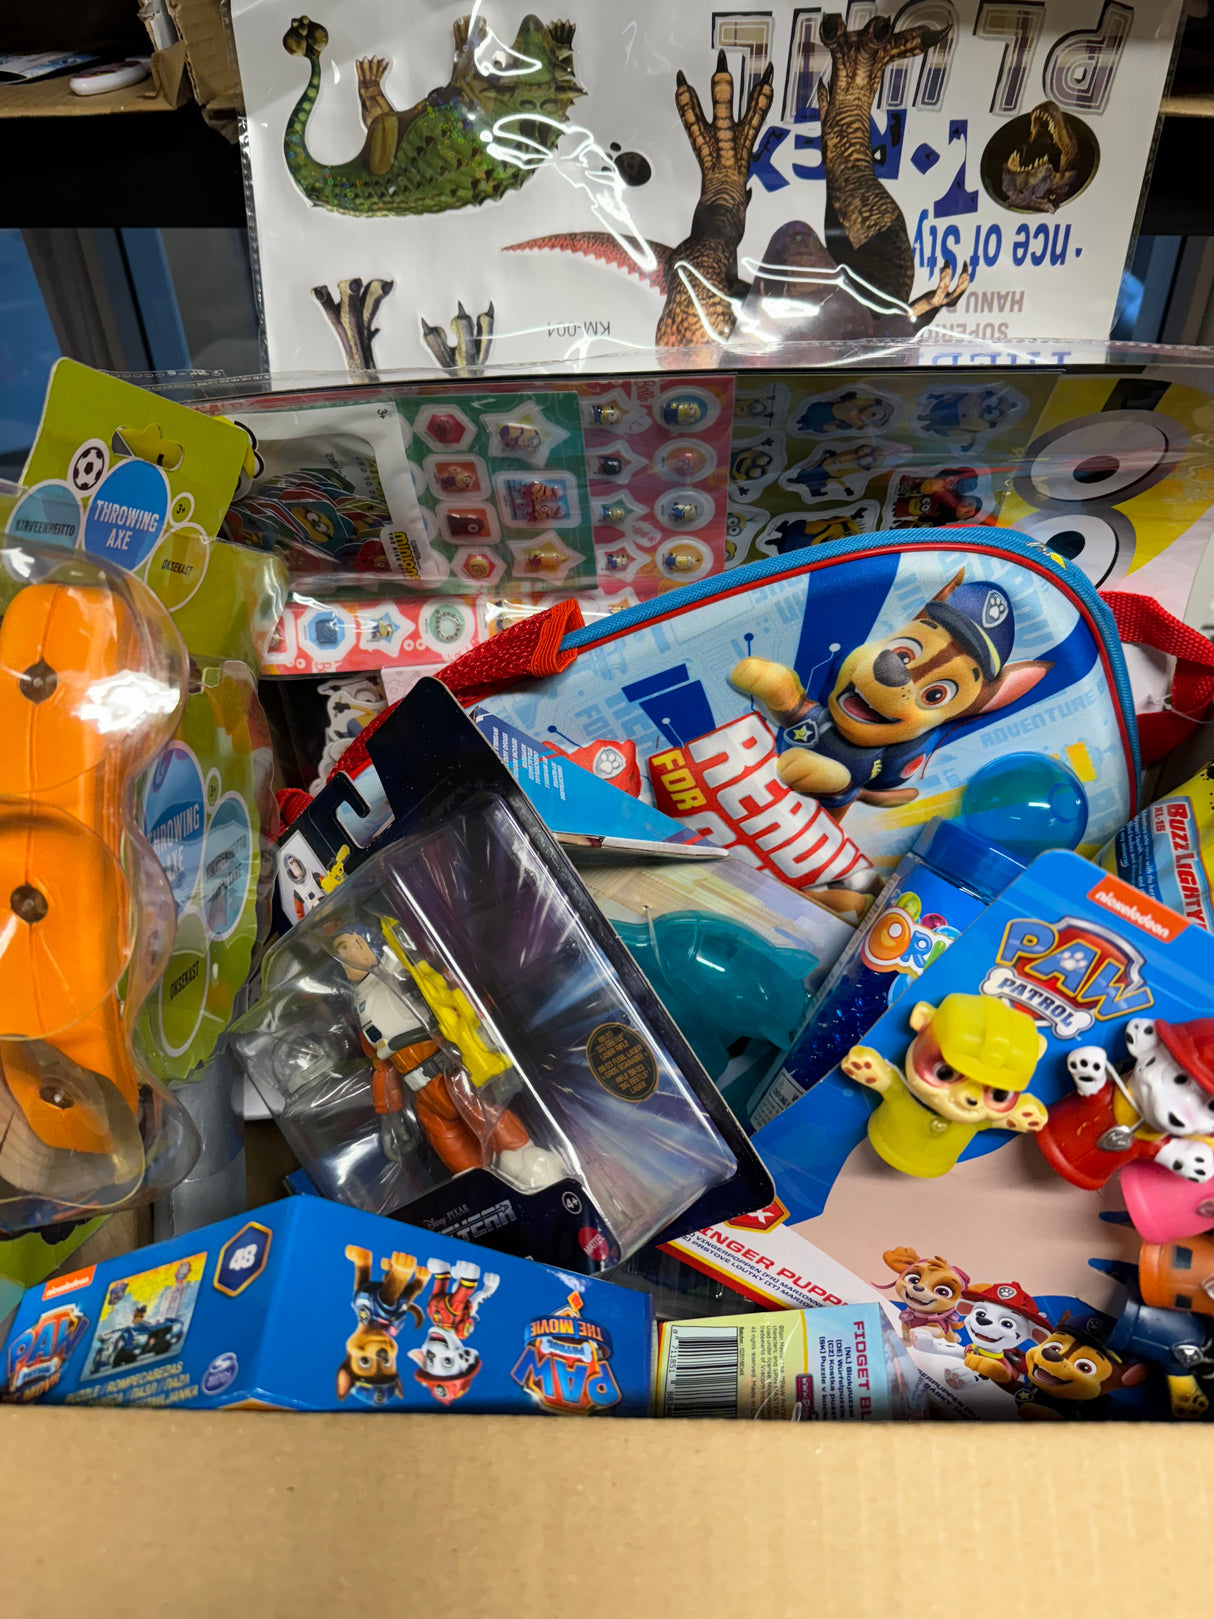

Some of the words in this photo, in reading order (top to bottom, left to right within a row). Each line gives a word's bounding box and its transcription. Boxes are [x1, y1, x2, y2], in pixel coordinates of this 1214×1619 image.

[913, 210, 965, 283] Sty
[972, 224, 1002, 282] of
[965, 290, 1025, 313] HANU
[93, 500, 160, 532] THROWING
[176, 504, 187, 515] 3+
[106, 528, 133, 550] AXE
[979, 690, 1097, 748] ADVENTURE
[651, 749, 708, 813] FOR
[688, 716, 873, 880] READY
[1166, 803, 1190, 851] BUZZ
[1095, 889, 1170, 938] nickelodeon
[1175, 852, 1208, 931] LIGHTY
[995, 918, 1154, 1021] PAW
[996, 976, 1073, 1028] PATROL
[447, 1203, 470, 1220] PIXAR
[565, 1196, 579, 1209] 4+
[229, 1244, 258, 1272] 48
[582, 1234, 607, 1256] MATTEL
[692, 1240, 730, 1265] PRSTOVÉ
[730, 1260, 765, 1282] LOUTKY
[765, 1278, 781, 1292] (IT)
[696, 1235, 762, 1275] VINGERPOPPEN
[763, 1272, 780, 1285] (FR)
[699, 1226, 775, 1270] INGER
[7, 1304, 89, 1375] PAW
[530, 1321, 574, 1336] MOVIE
[581, 1323, 604, 1341] THE
[827, 1339, 835, 1354] (CZ)
[511, 1344, 622, 1406] PAW
[853, 1321, 870, 1391] FIDGET
[861, 1392, 873, 1420] BL
